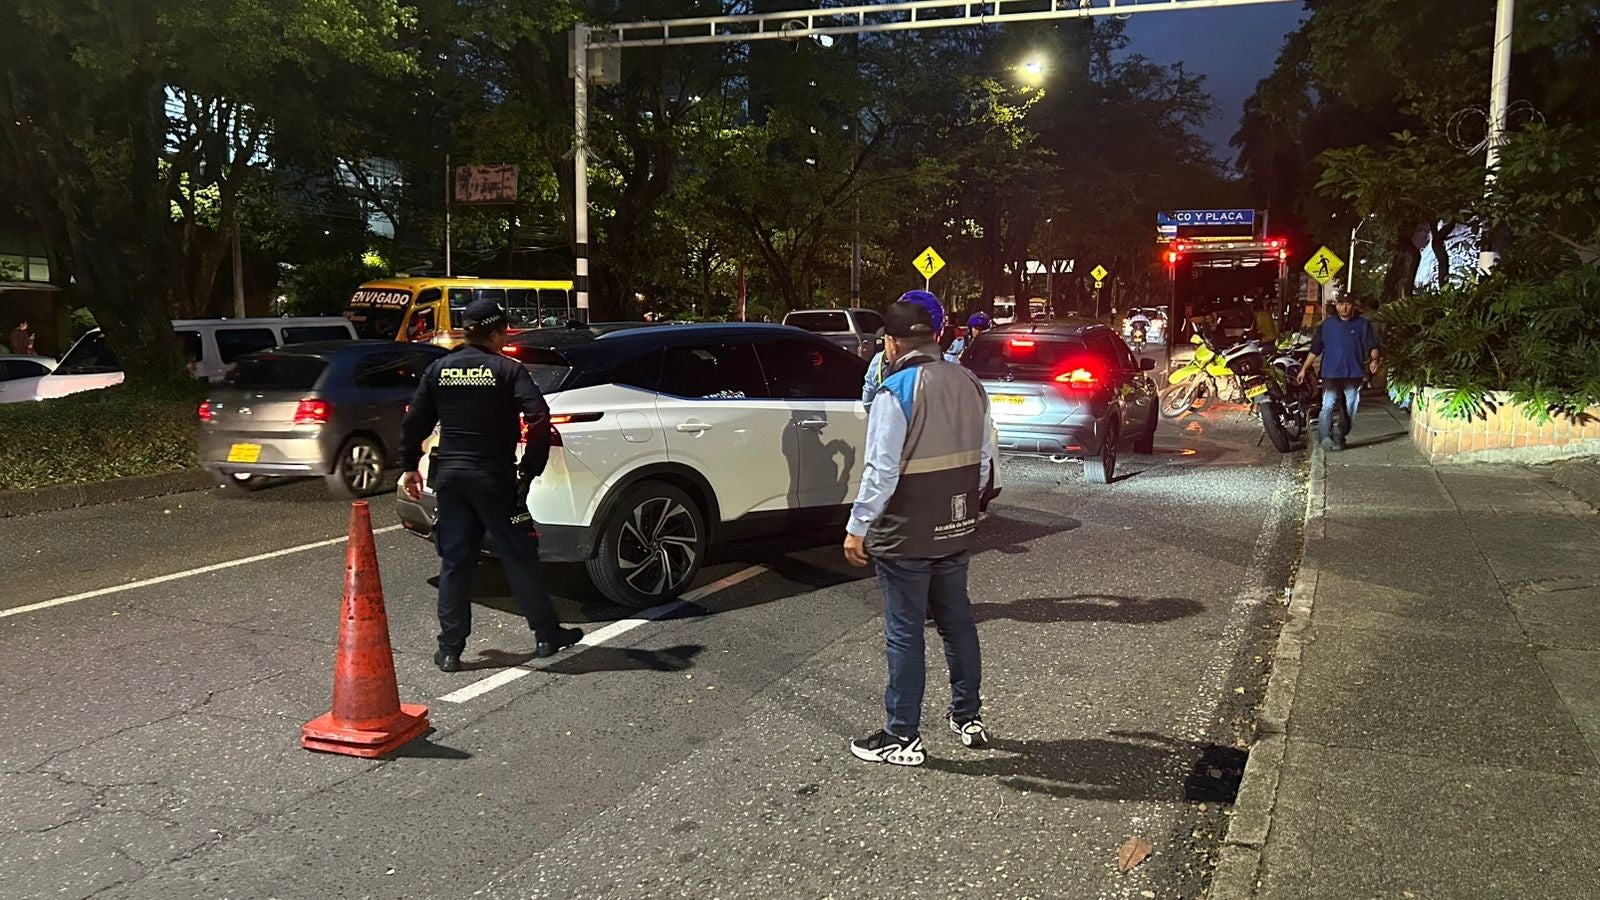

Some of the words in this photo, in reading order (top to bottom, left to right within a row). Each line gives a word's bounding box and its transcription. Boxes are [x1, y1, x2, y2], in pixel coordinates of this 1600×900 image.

[1195, 212, 1203, 221] Y
[1205, 212, 1243, 221] PLACA
[351, 291, 410, 306] ENVIGADO
[441, 364, 493, 378] POLICÍA
